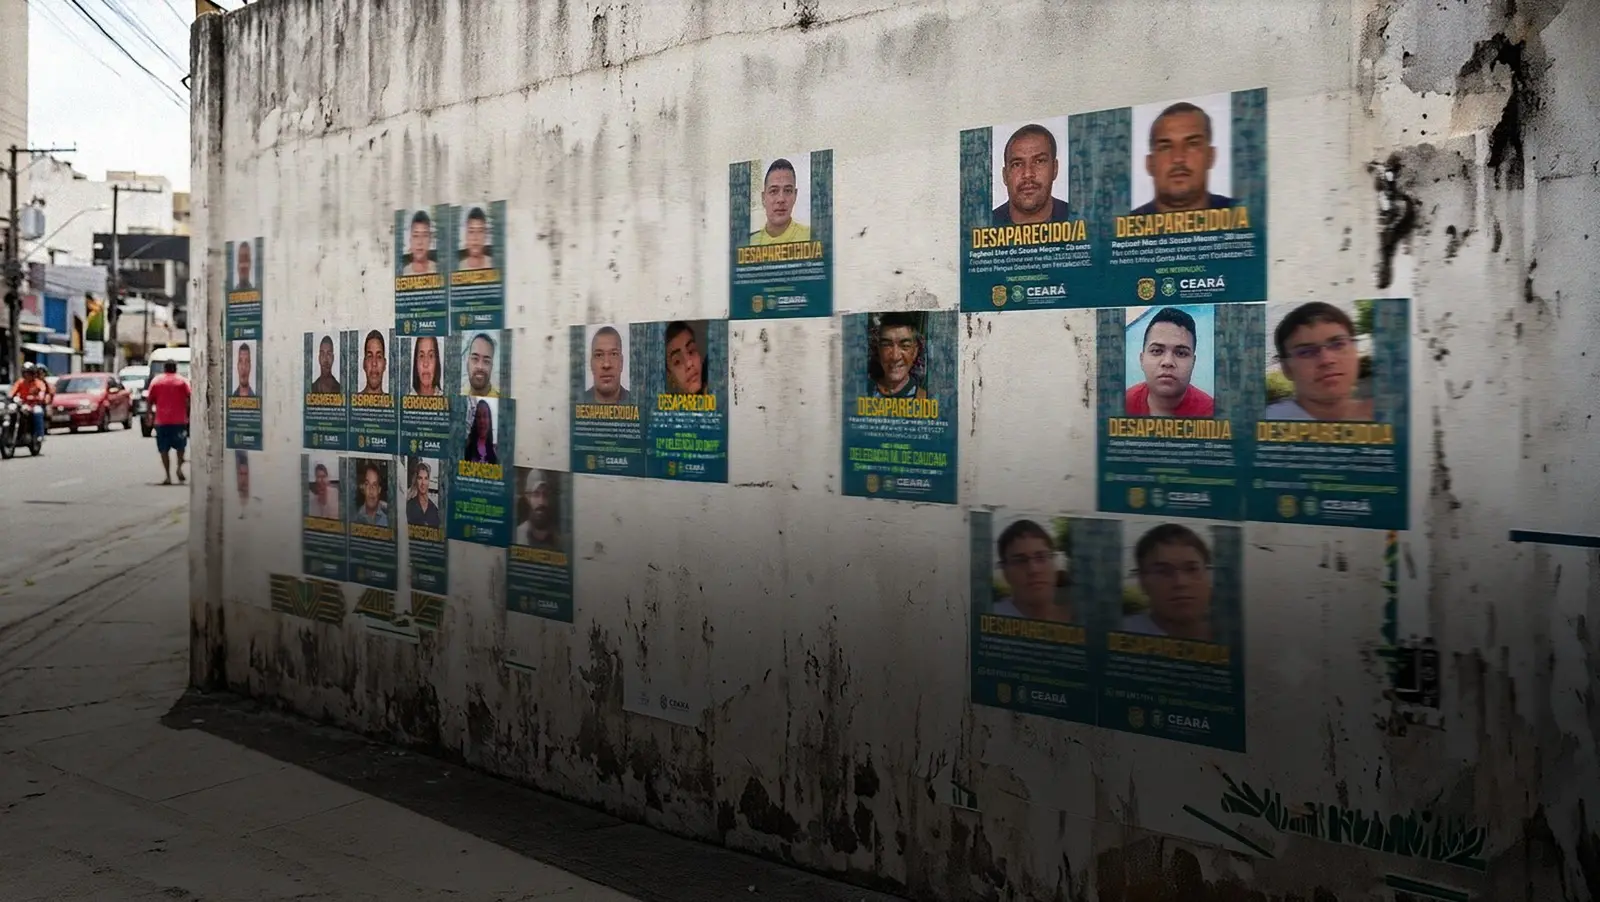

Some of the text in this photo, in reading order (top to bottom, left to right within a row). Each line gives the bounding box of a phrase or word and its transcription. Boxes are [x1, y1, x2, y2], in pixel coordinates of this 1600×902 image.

[1116, 206, 1249, 238] DESAPARECIDO/A
[973, 220, 1086, 248] DESAPARECIDO/A
[1026, 283, 1067, 296] CEARÁ
[1180, 275, 1225, 289] CEARÁ
[858, 397, 938, 419] DESAPARECIDO
[1168, 713, 1211, 731] CEARÁ
